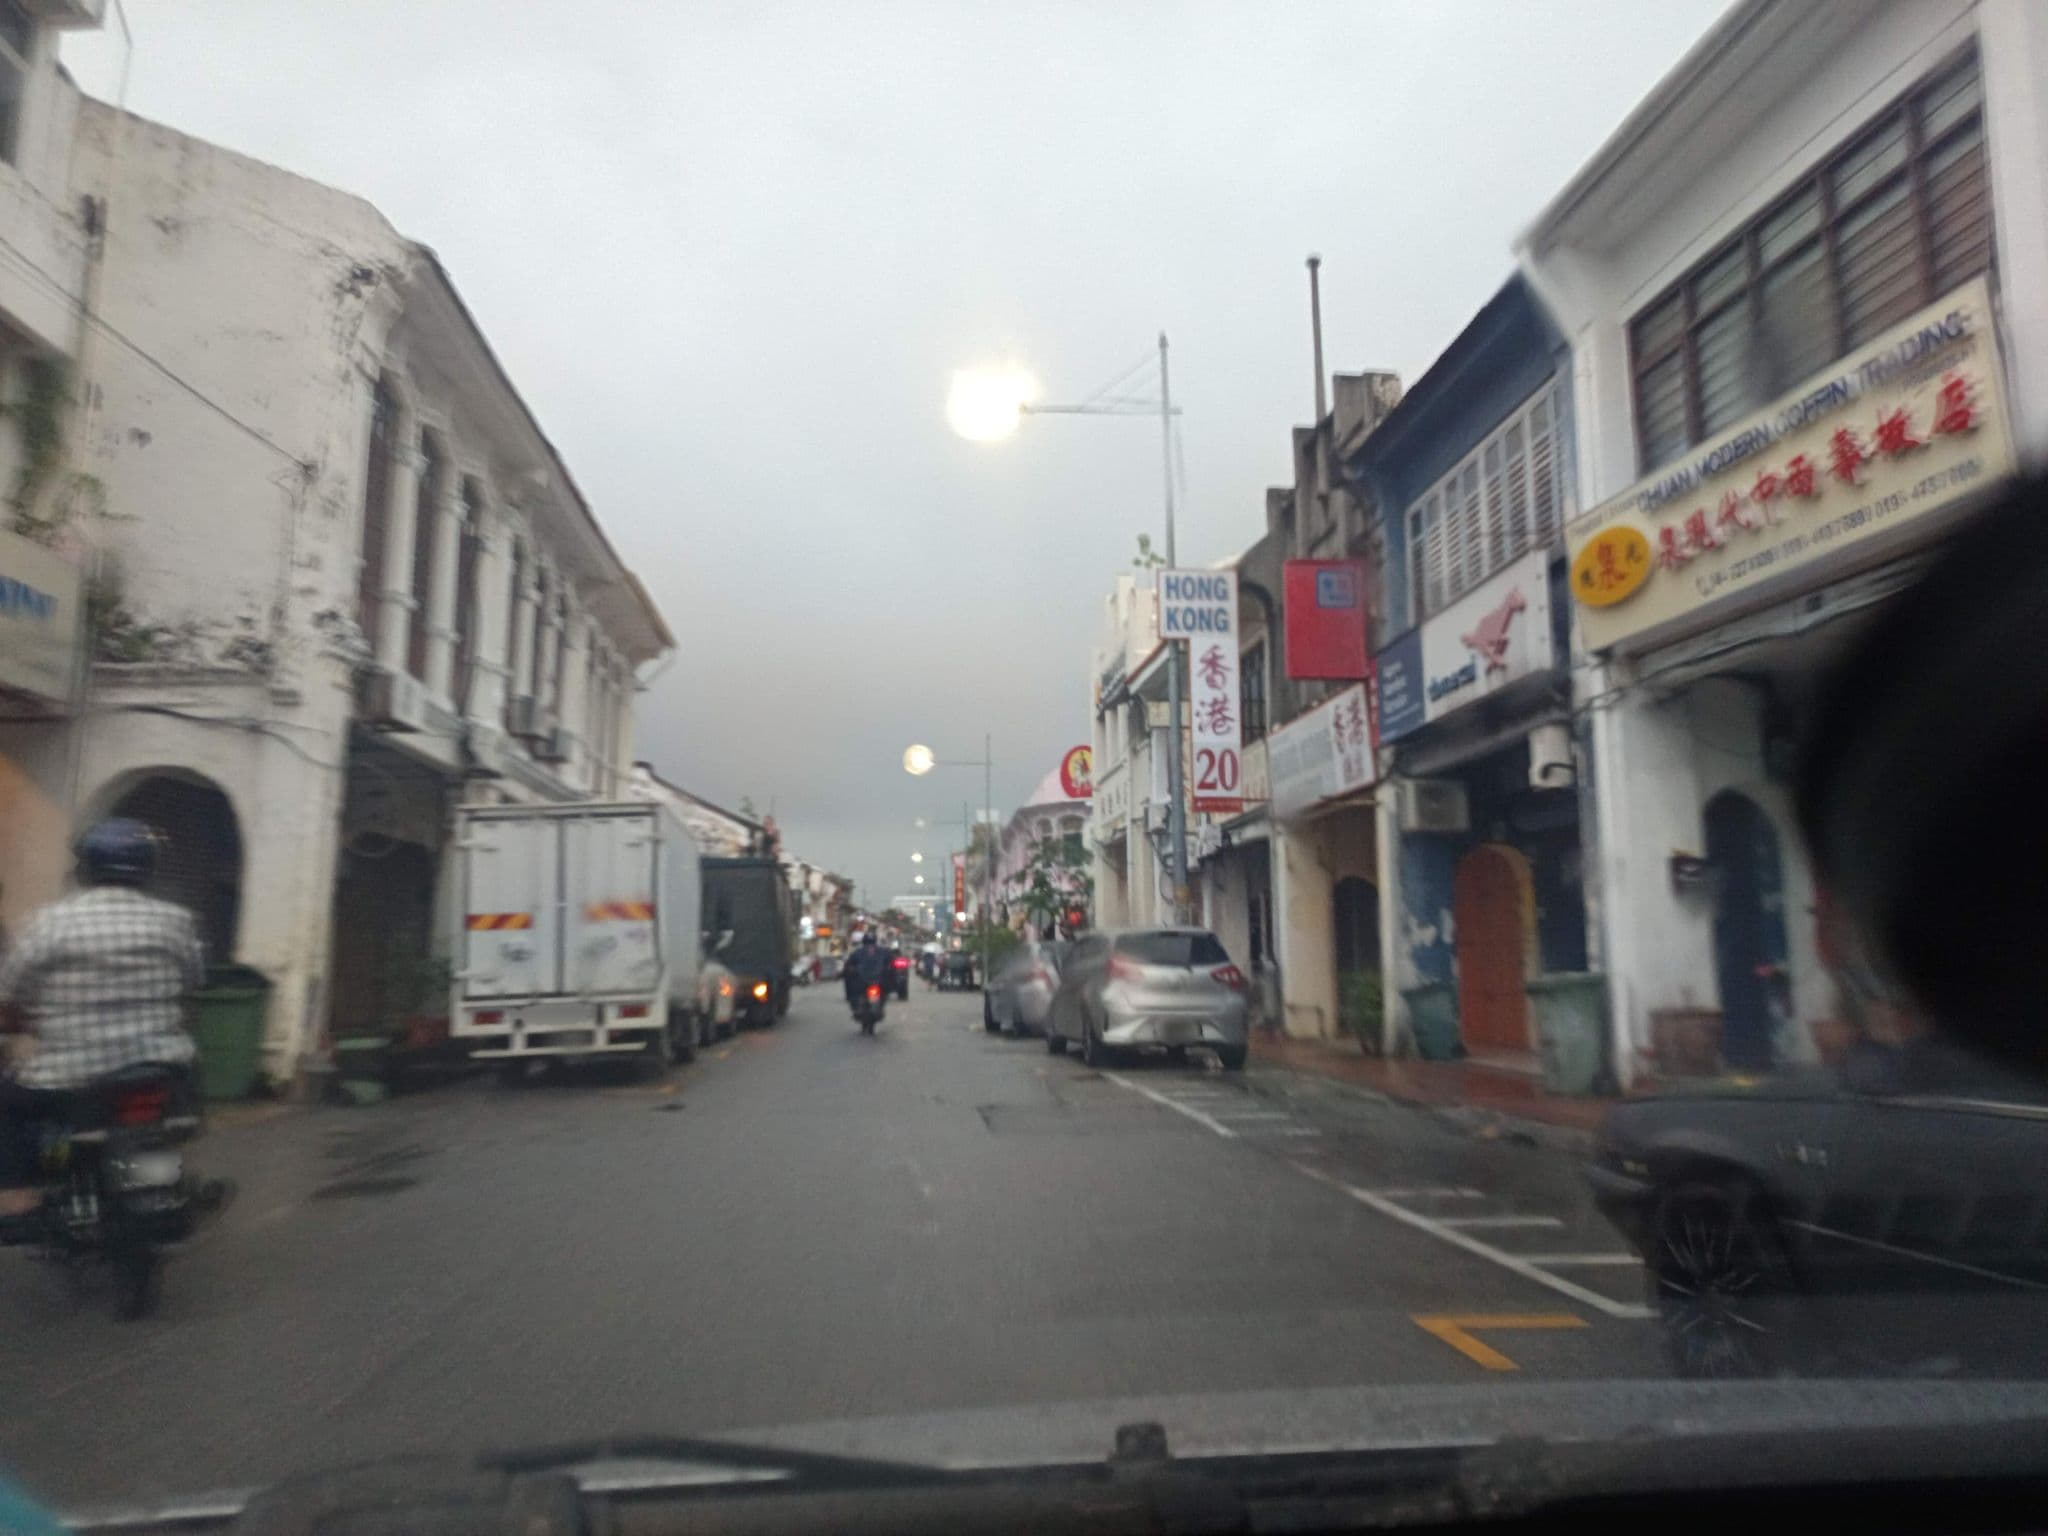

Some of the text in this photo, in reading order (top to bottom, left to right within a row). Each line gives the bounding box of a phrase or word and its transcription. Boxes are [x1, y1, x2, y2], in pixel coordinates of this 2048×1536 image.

[1697, 423, 1771, 480] MODERN
[1165, 575, 1228, 600] HONG
[1165, 607, 1230, 632] KONG
[1195, 644, 1235, 736] 香港
[1196, 748, 1239, 791] 20
